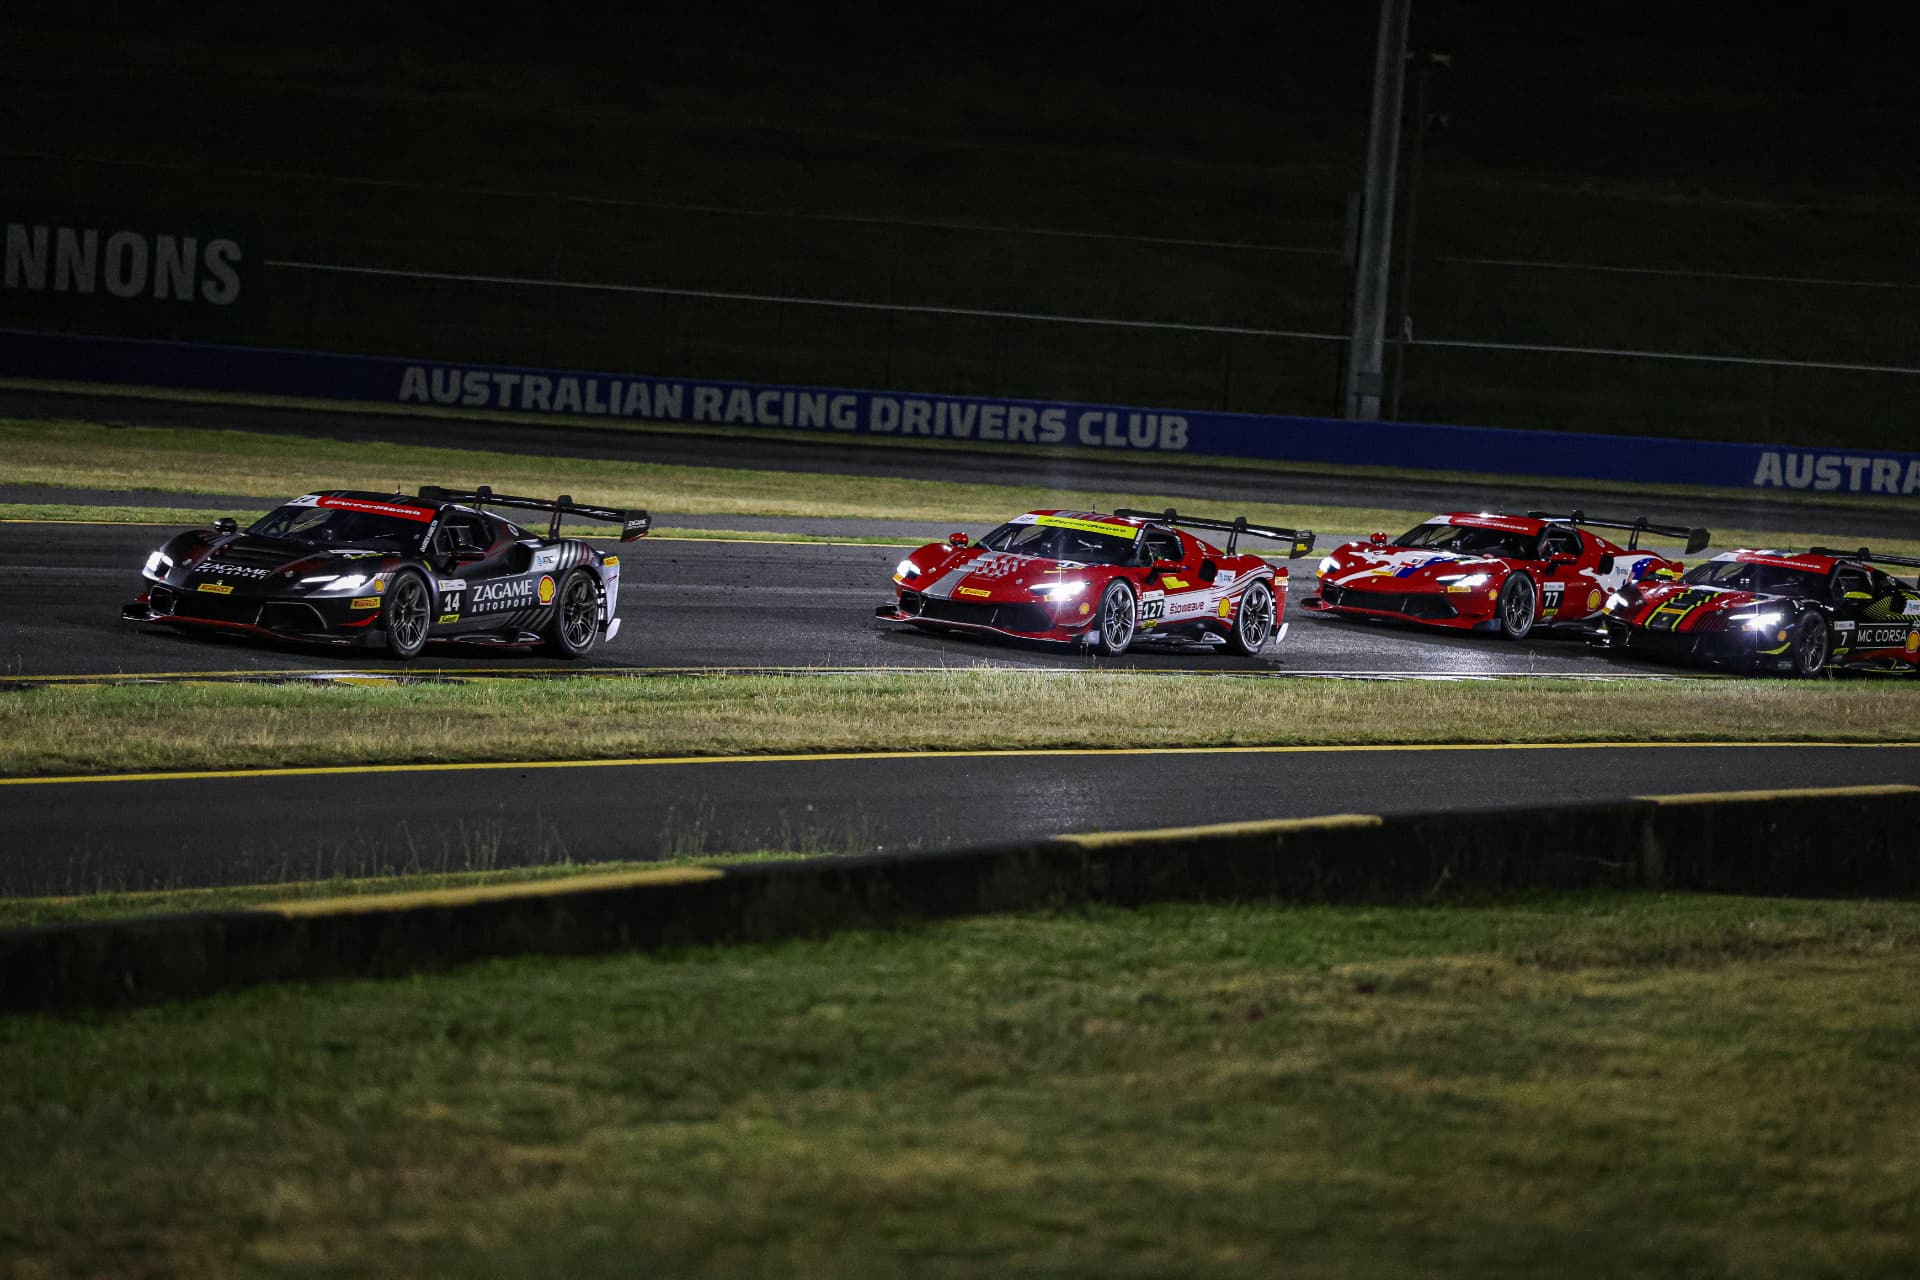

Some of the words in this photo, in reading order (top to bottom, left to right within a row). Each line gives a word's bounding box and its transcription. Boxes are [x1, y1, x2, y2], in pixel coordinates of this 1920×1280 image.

[400, 366, 684, 419] AUSTRALIAN
[692, 386, 857, 430] RACING
[869, 397, 1066, 443] DRIVERS
[1079, 411, 1189, 450] CLUB
[198, 562, 271, 576] ZAGAME
[473, 579, 533, 602] ZAGAME
[444, 592, 460, 611] 14
[472, 597, 532, 613] AUTOSPORT
[1545, 591, 1559, 607] 77
[1142, 601, 1164, 619] 127
[1841, 631, 1848, 646] 7
[1857, 629, 1874, 643] MC
[1875, 629, 1907, 643] CORSA
